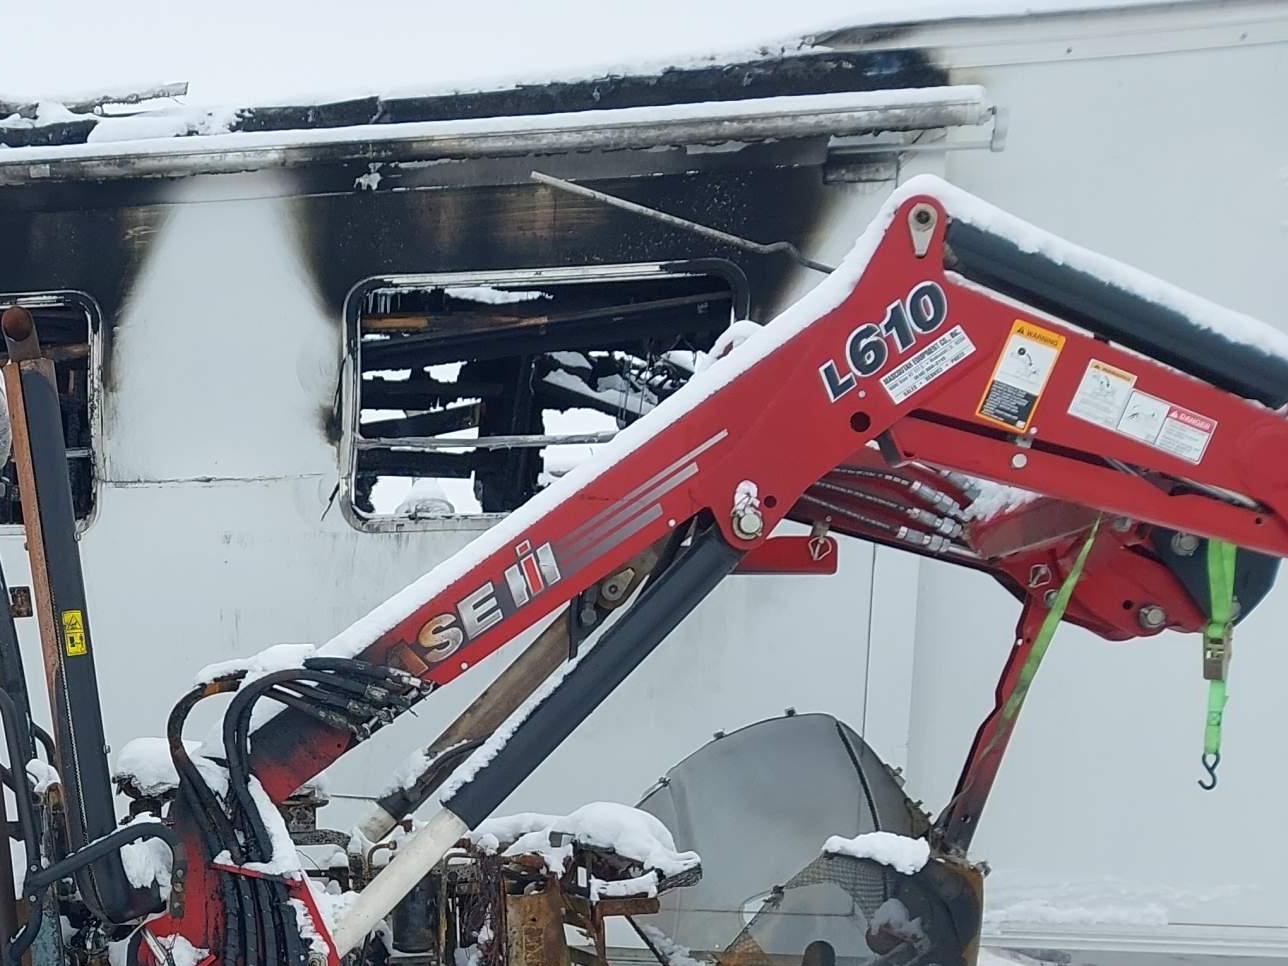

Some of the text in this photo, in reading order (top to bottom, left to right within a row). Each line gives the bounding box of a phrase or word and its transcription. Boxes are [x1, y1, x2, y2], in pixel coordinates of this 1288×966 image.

[818, 281, 948, 403] L610
[1025, 330, 1058, 345] WARNING
[911, 342, 940, 364] EQUIPMENT
